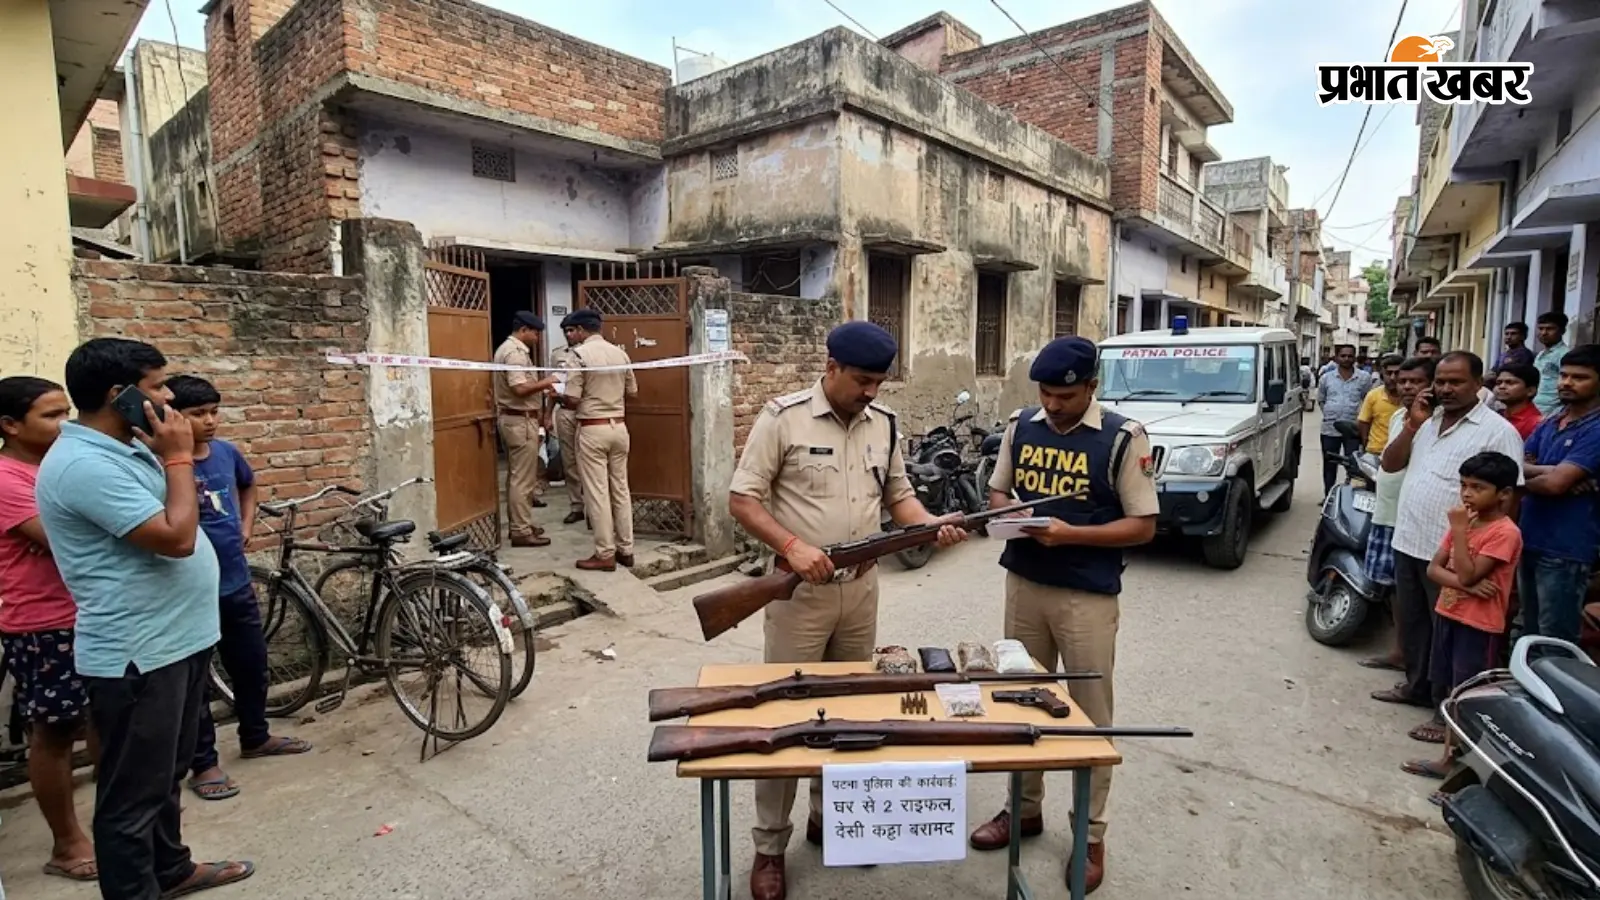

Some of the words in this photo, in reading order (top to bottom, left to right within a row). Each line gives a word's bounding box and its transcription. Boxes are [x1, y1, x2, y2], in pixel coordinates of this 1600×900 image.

[1122, 349, 1168, 358] PATNA
[1173, 348, 1228, 357] POLICE
[1019, 444, 1089, 475] PATNA
[1015, 468, 1091, 500] POLICE
[832, 780, 858, 790] पटना
[862, 776, 893, 792] पुलिस
[898, 776, 912, 788] की
[833, 801, 854, 813] घर
[863, 795, 875, 813] से
[883, 800, 892, 813] 2
[900, 798, 955, 813] राइफल,
[835, 821, 864, 838] देसी
[872, 824, 902, 840] कट्टा
[910, 822, 955, 837] बरामद
